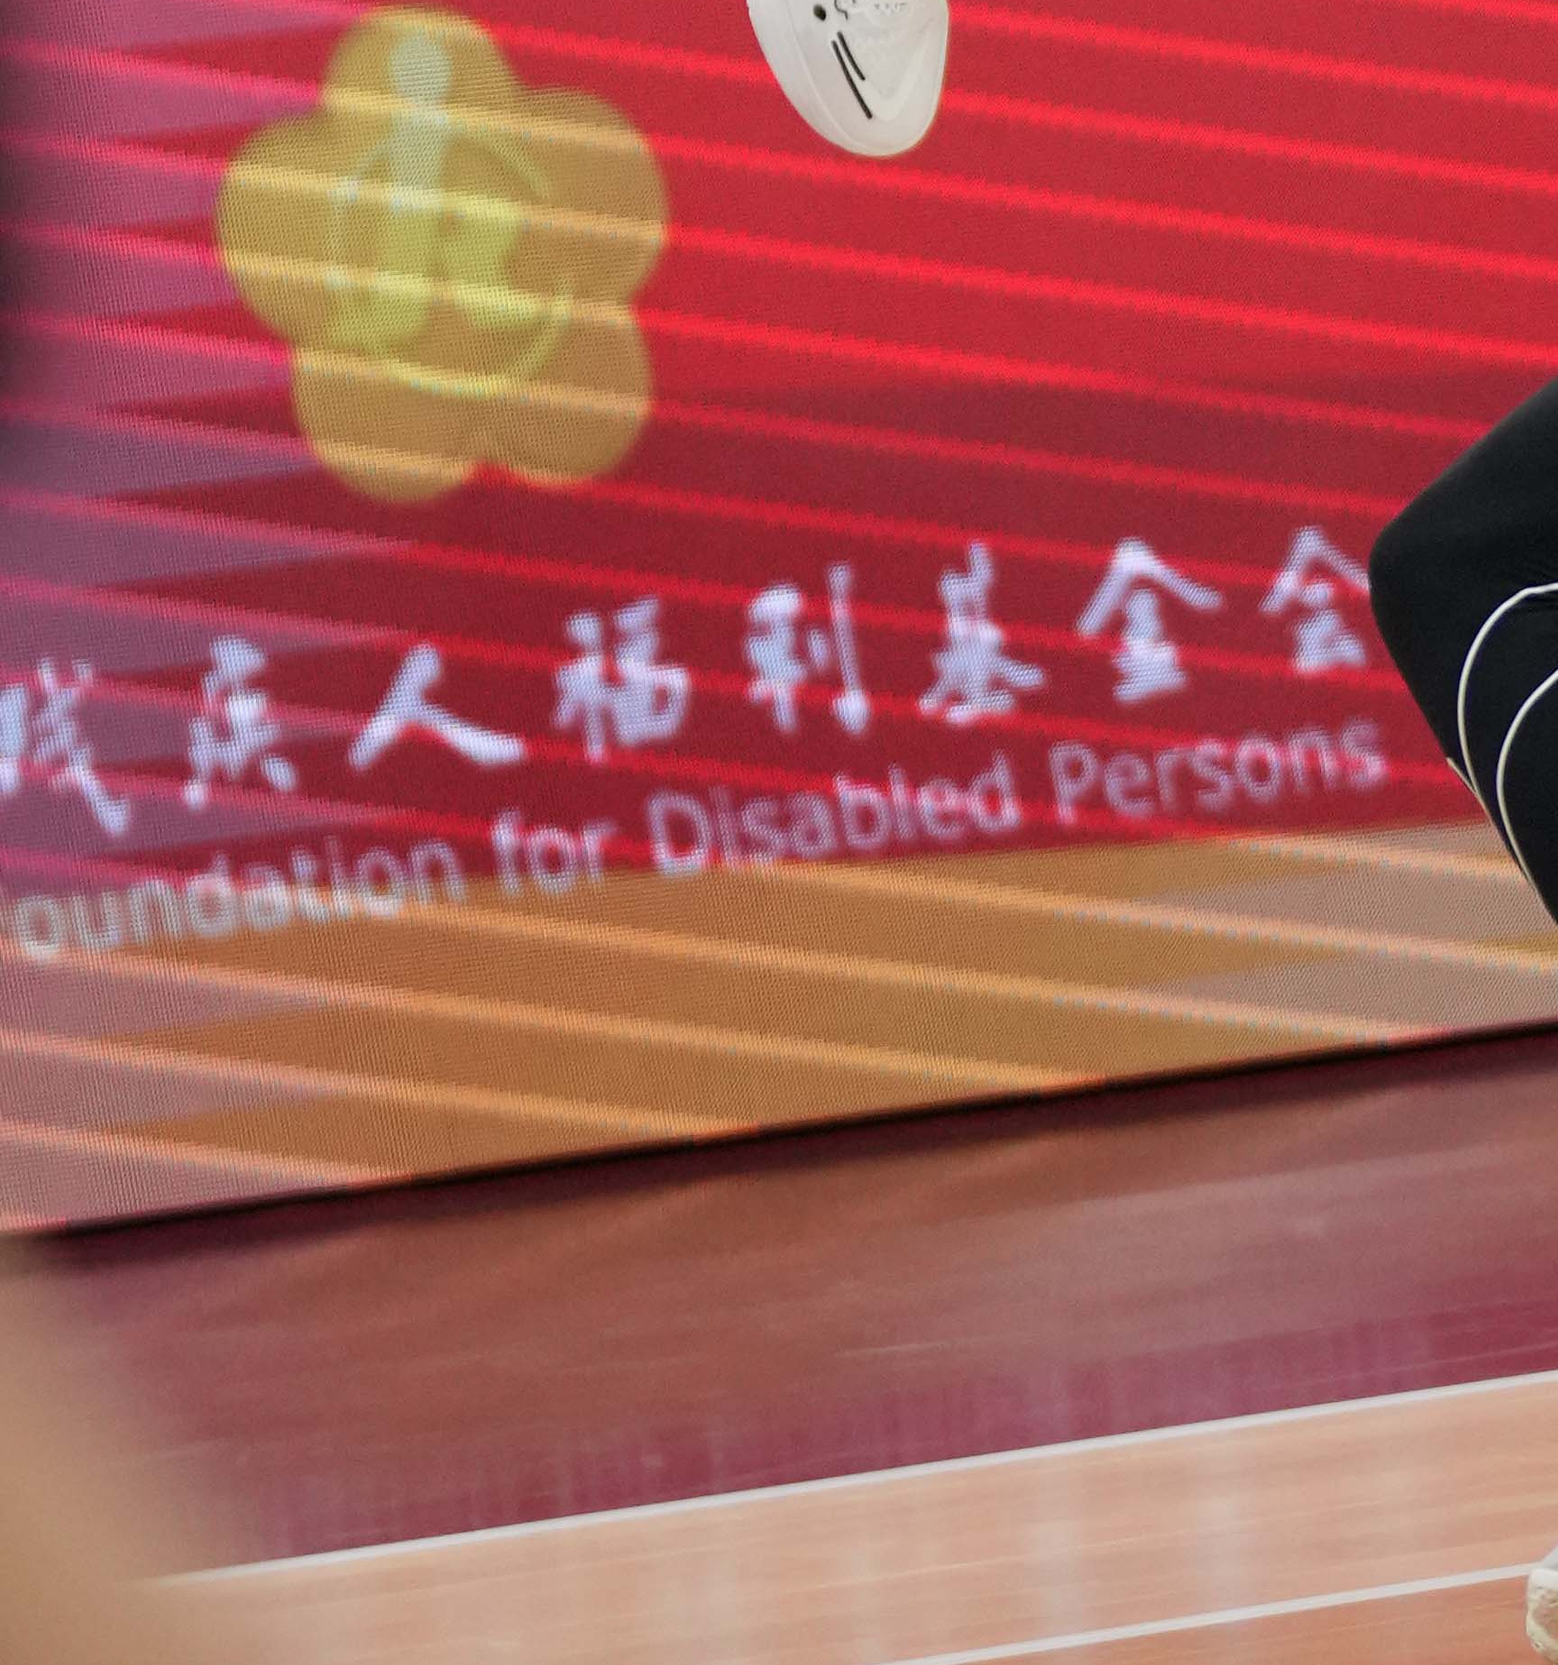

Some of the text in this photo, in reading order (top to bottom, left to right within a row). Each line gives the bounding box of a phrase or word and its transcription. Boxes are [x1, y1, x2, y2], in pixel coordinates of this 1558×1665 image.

[492, 808, 614, 894] for
[647, 749, 1020, 877] Disabled
[1048, 717, 1389, 825] Persons
